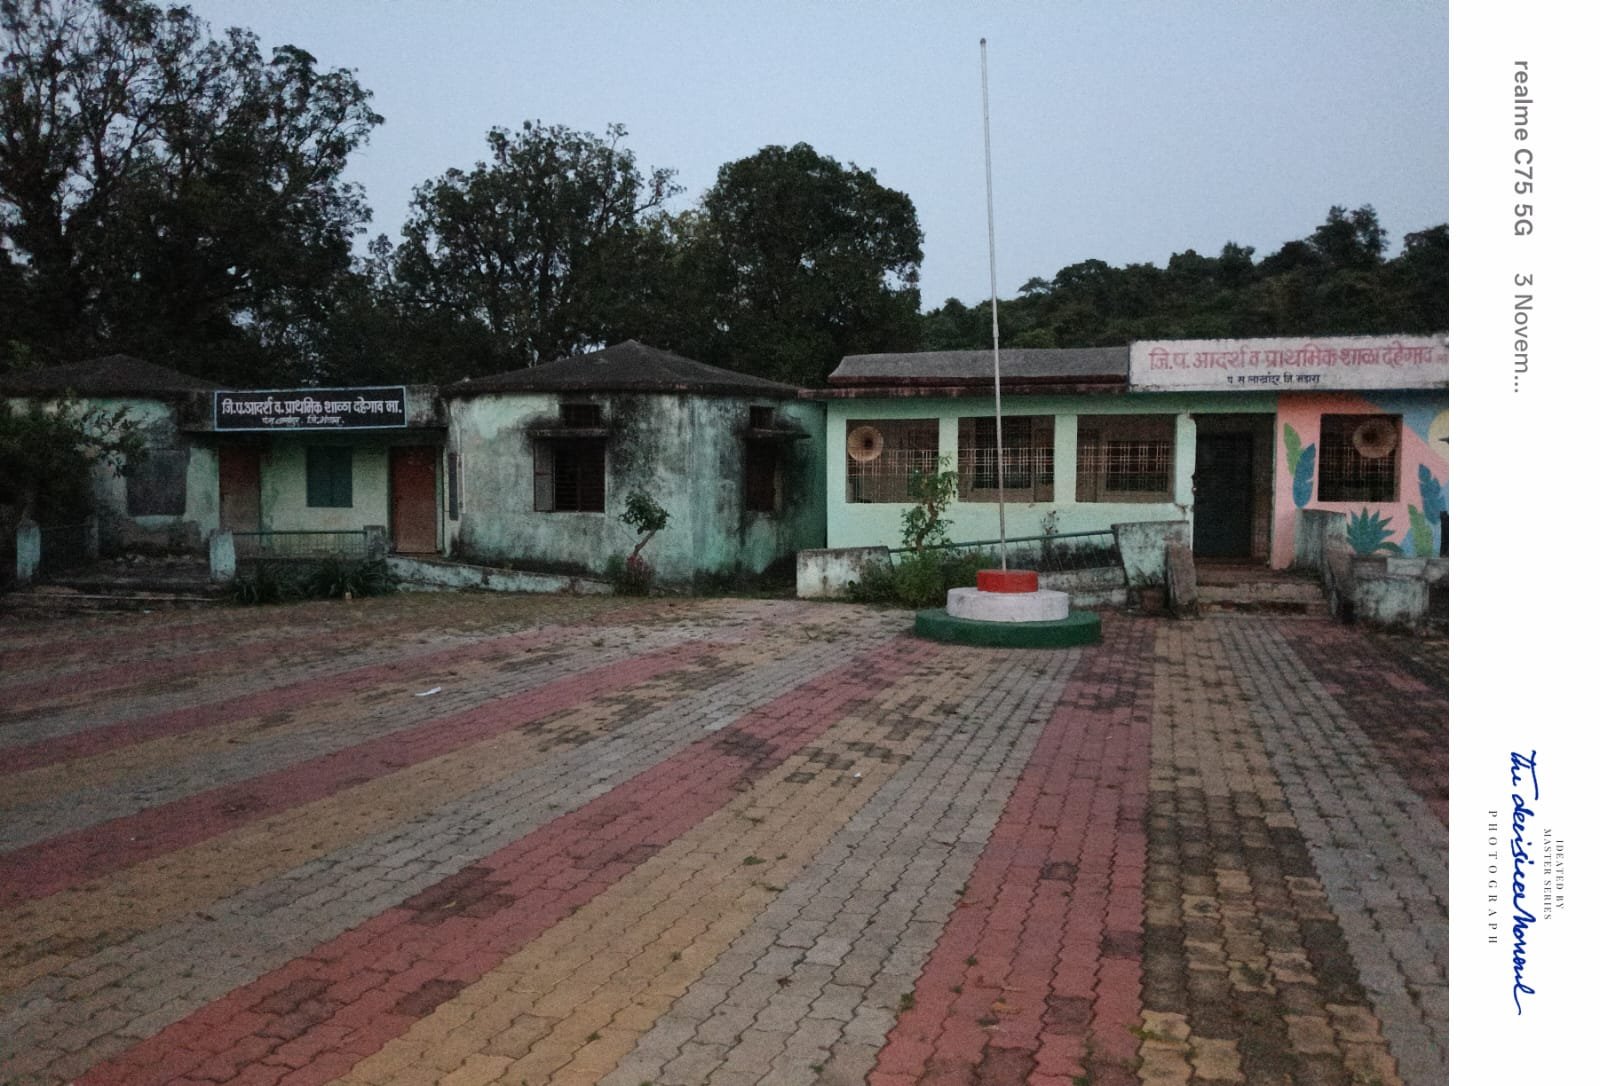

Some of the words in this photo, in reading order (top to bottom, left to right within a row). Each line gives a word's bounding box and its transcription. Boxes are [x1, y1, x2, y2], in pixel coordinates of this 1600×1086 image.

[1264, 343, 1337, 369] प्राथमिक
[285, 397, 323, 415] प्राथमिक
[324, 401, 352, 414] शाळा
[353, 396, 384, 414] दहेगाव
